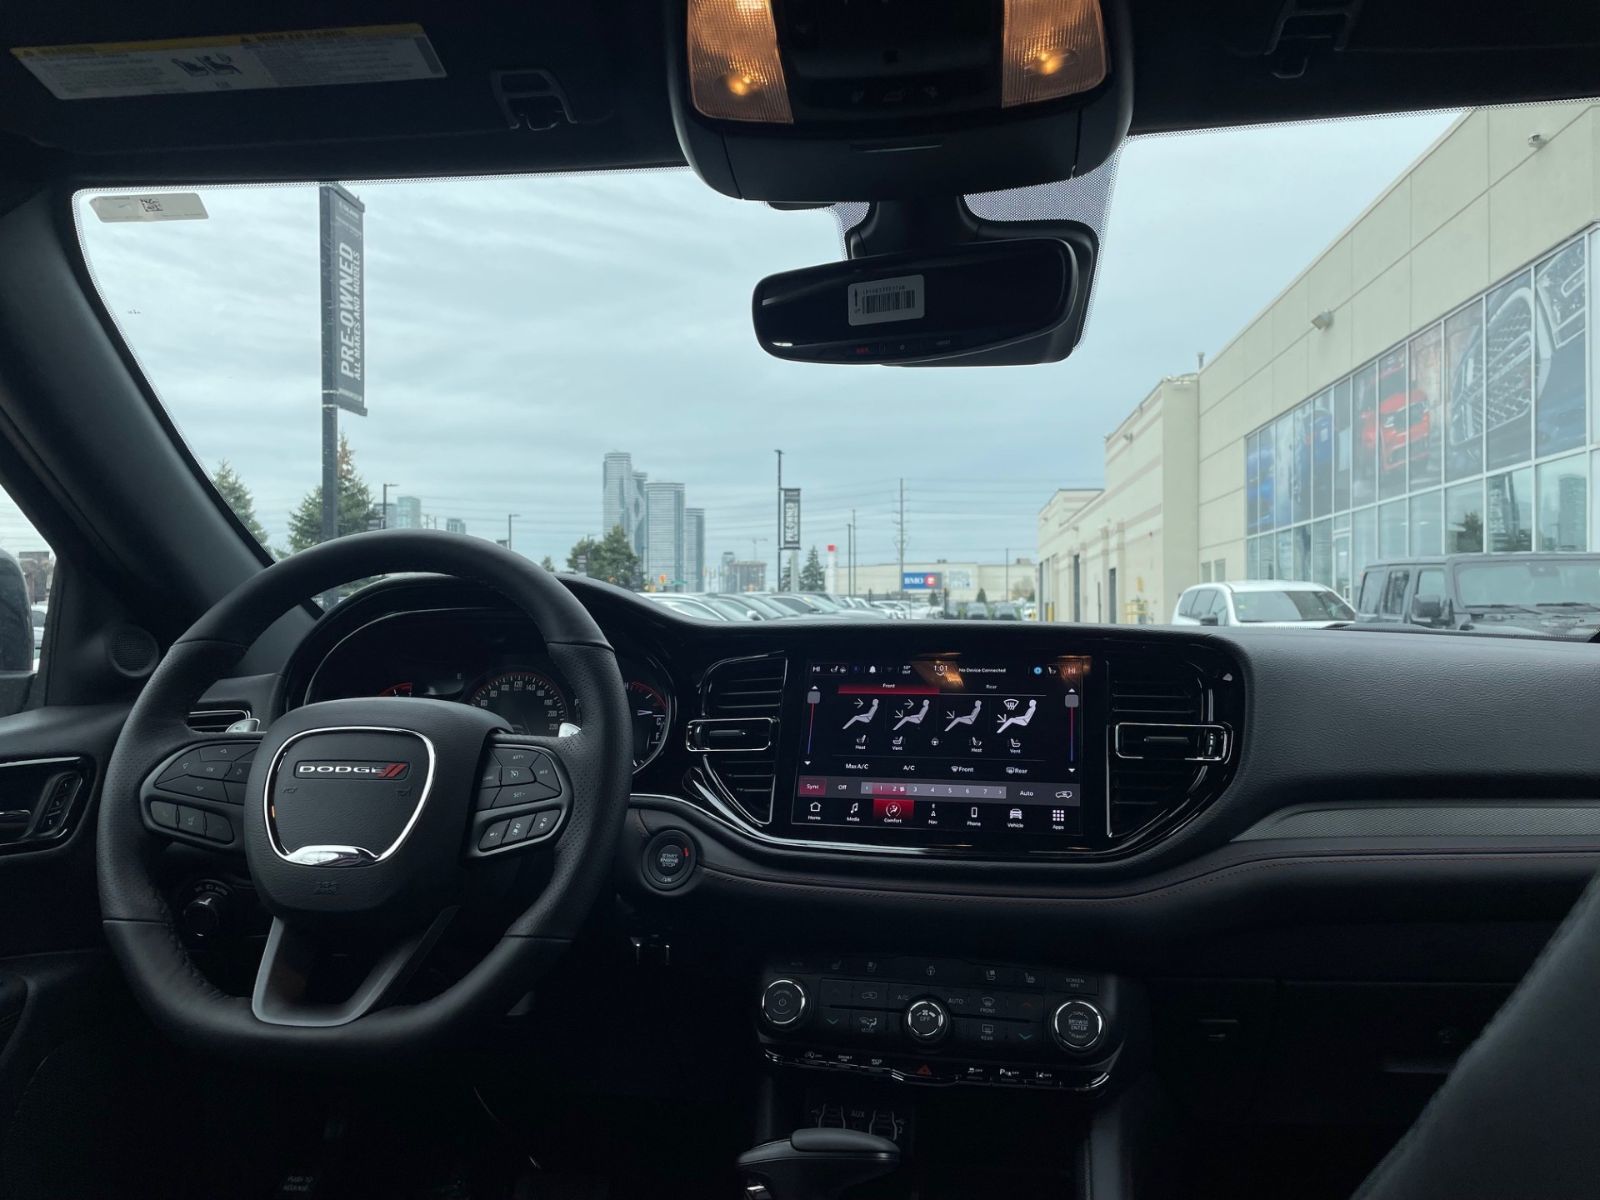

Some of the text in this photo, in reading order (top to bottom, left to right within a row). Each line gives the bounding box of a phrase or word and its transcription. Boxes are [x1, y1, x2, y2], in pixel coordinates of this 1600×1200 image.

[339, 242, 355, 378] PRE-OWNED
[352, 250, 361, 381] ALL MAKES AND MODELS
[806, 783, 820, 791] Sync
[851, 1110, 865, 1118] AUX
